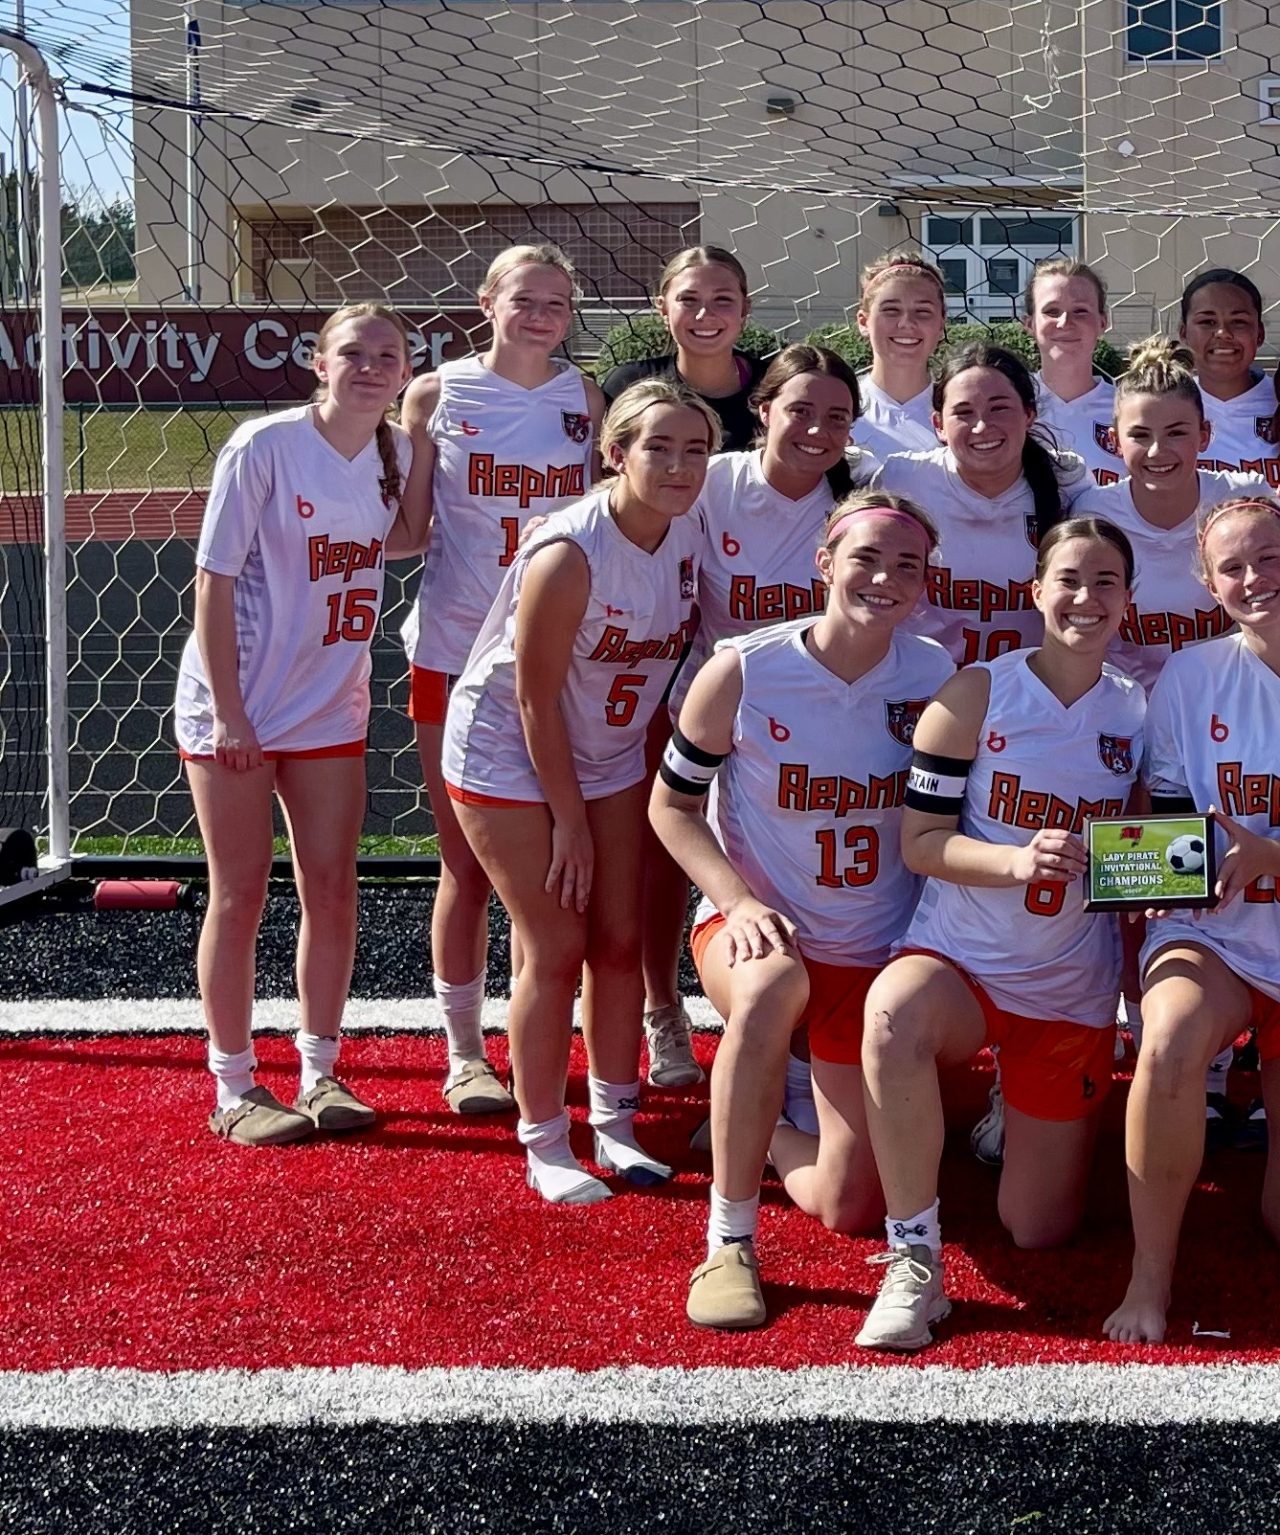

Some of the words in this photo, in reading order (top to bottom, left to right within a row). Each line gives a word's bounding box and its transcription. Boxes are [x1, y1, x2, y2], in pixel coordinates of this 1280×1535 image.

[243, 318, 453, 370] Ceer
[499, 517, 519, 567] 1
[322, 588, 377, 646] 15
[605, 674, 648, 727] 5
[910, 771, 939, 793] PTAIN
[815, 825, 879, 888] 13
[1099, 874, 1164, 887] CHAMPIONS
[1100, 862, 1162, 872] INVITATIONAL
[1102, 852, 1125, 862] LADY
[1127, 851, 1160, 861] PIRATE
